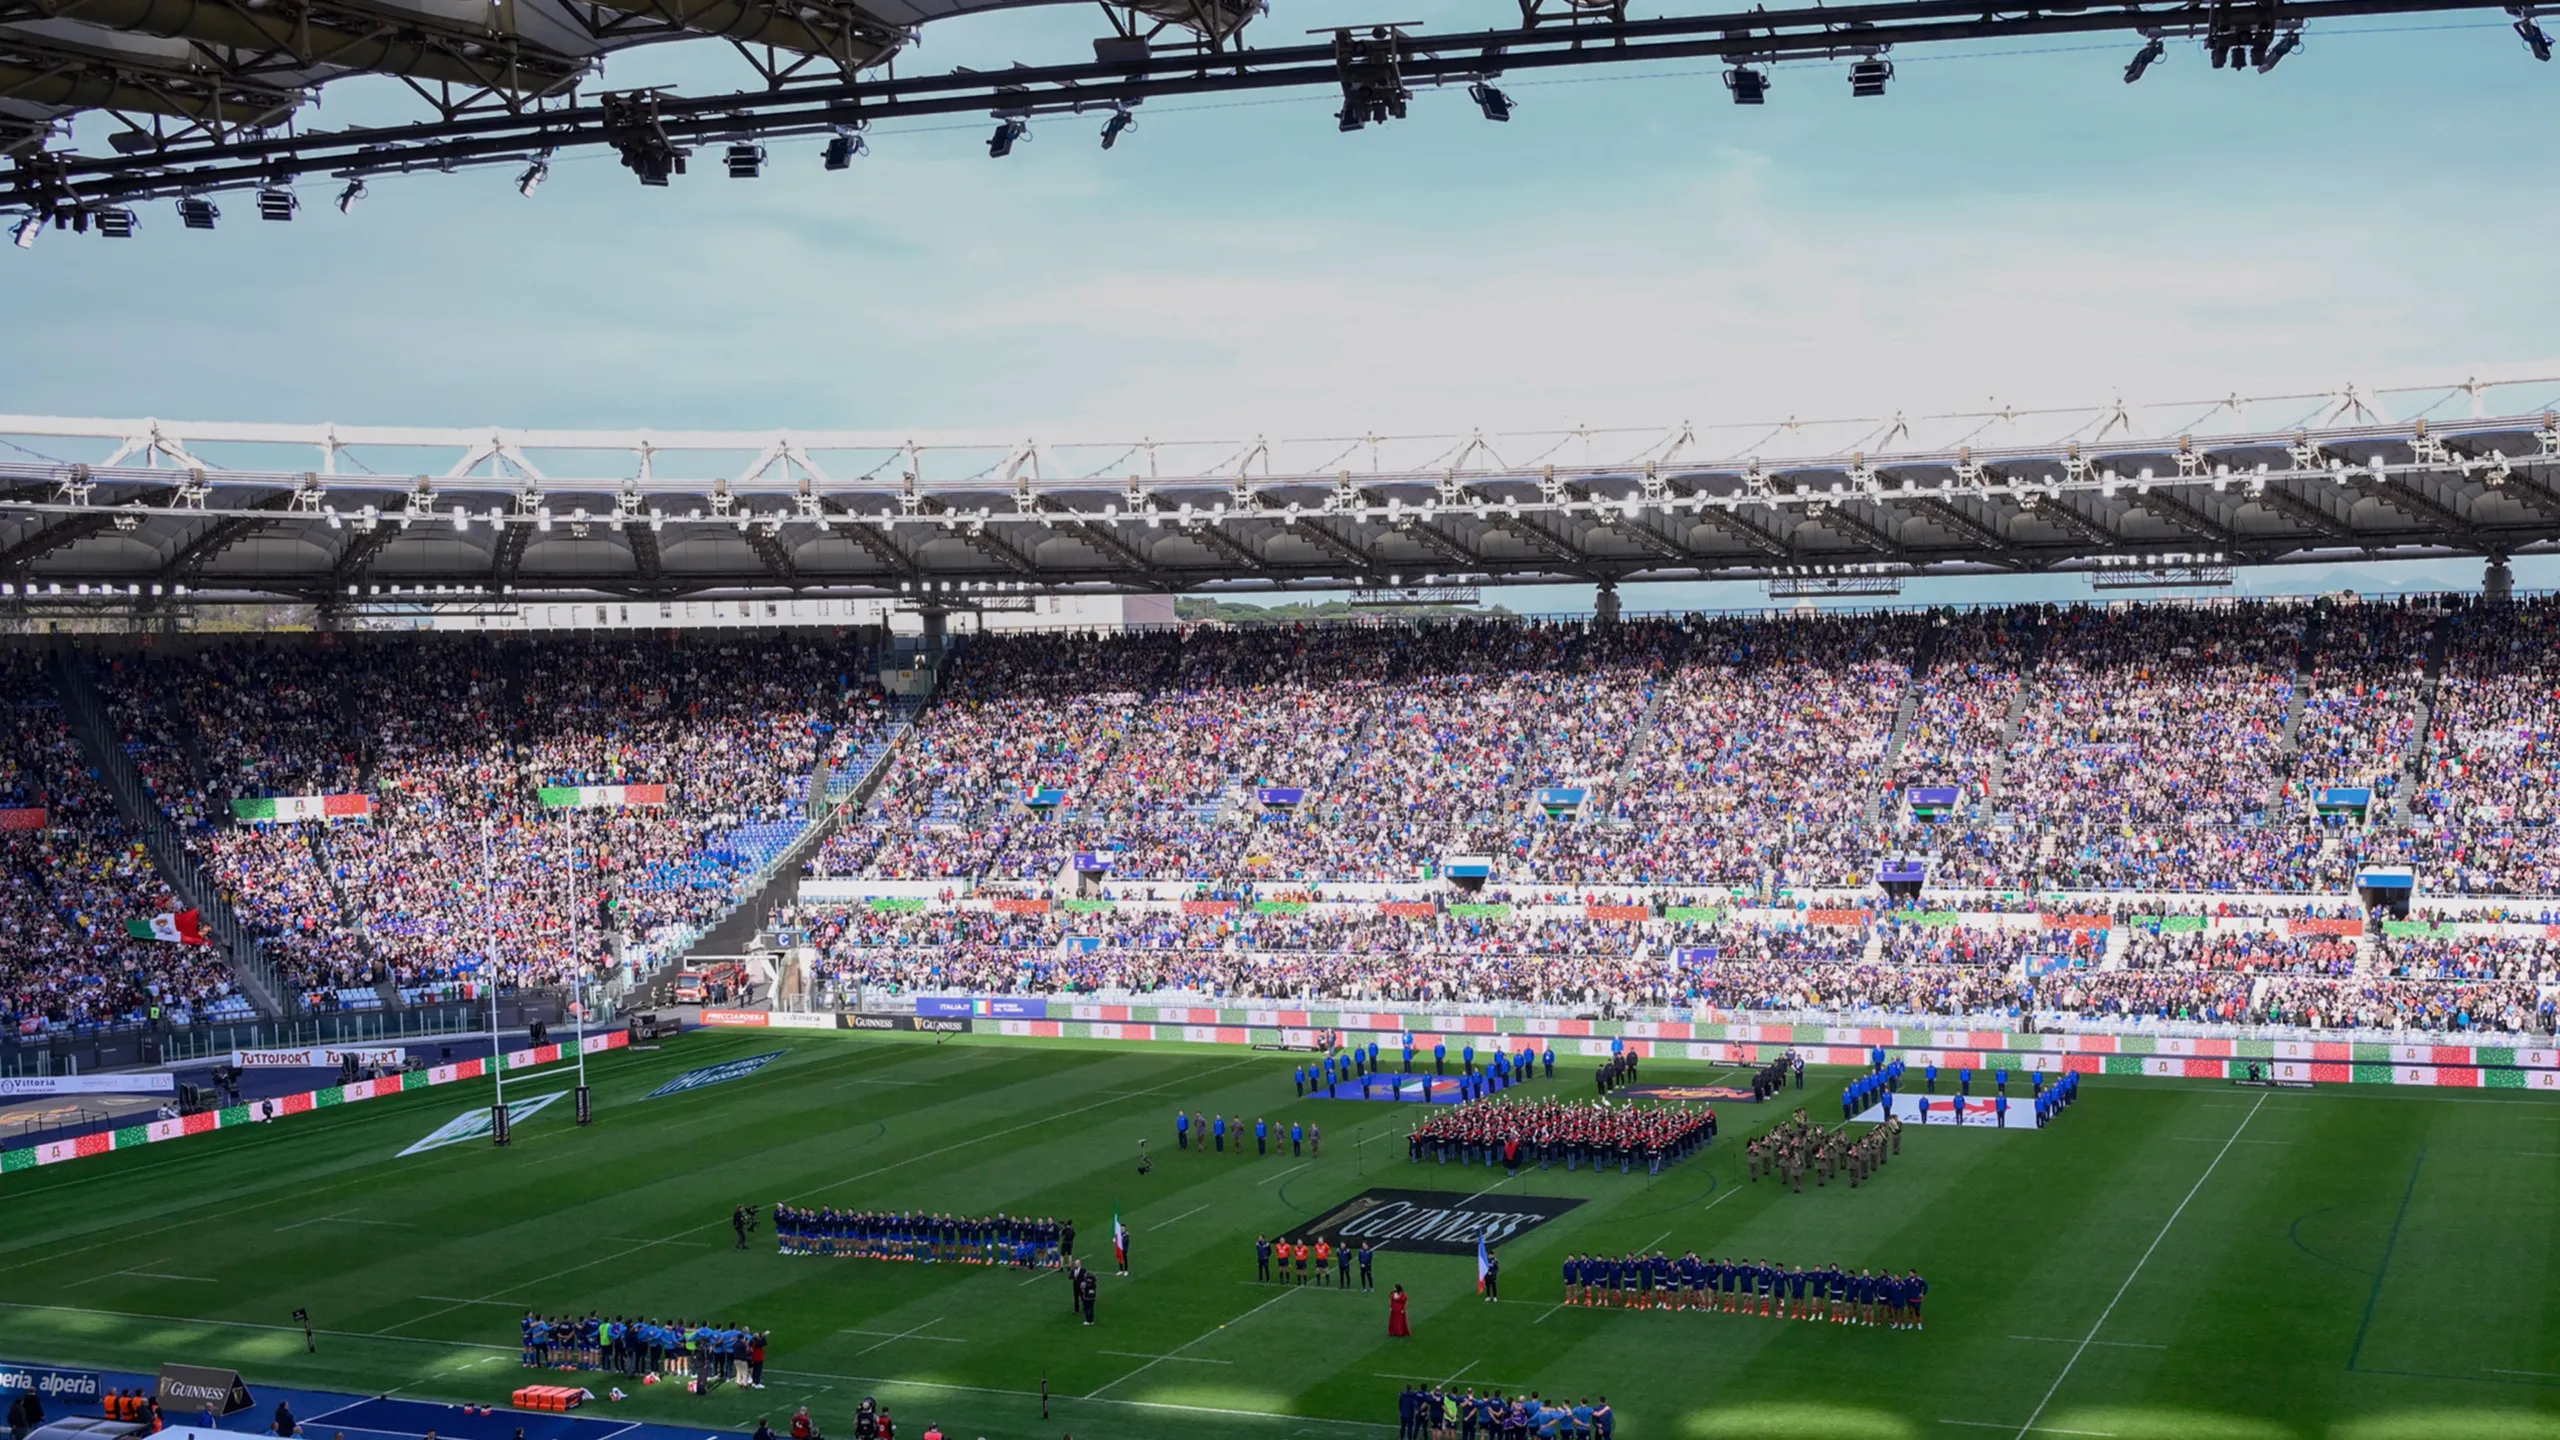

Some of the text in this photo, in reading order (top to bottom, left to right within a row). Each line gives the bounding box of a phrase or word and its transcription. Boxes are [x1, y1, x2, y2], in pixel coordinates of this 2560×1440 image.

[855, 1017, 894, 1028] GUINNESS
[240, 1050, 312, 1065] TUTTOSPORT
[14, 1078, 56, 1088] Vittoria
[1338, 1201, 1546, 1245] GUINNESS
[39, 1372, 96, 1397] alperia
[171, 1382, 227, 1401] GUINNESS
